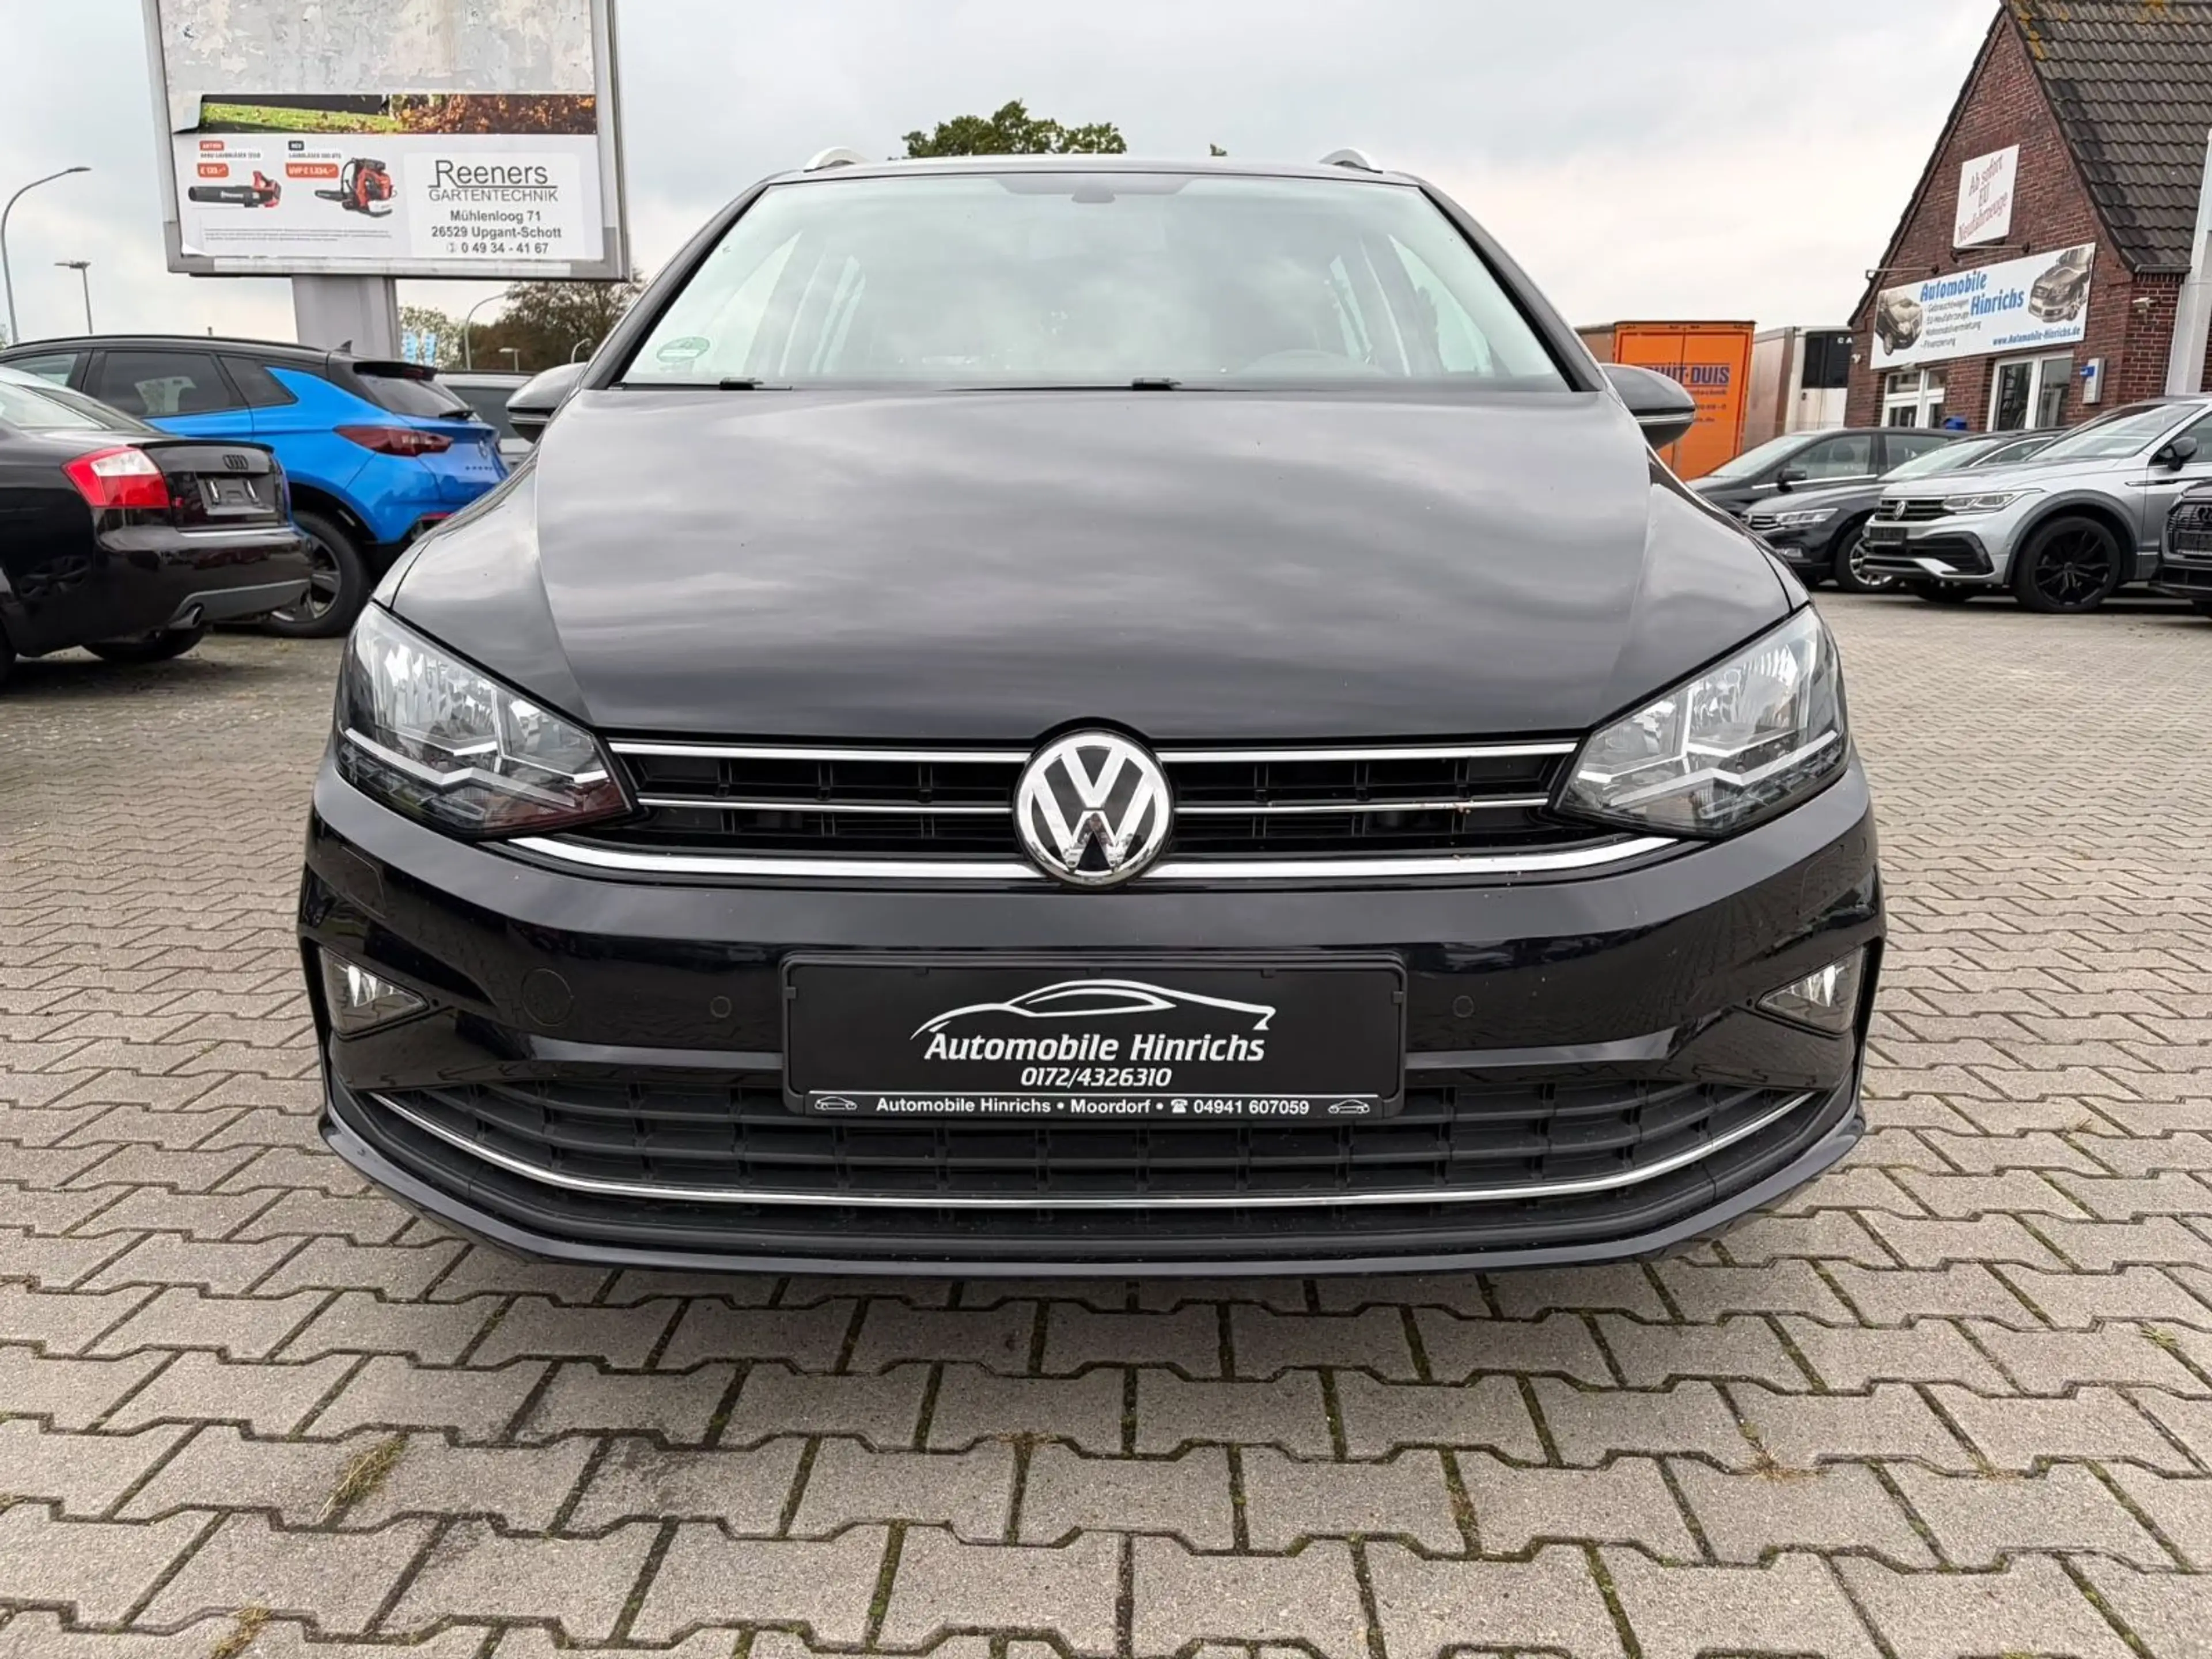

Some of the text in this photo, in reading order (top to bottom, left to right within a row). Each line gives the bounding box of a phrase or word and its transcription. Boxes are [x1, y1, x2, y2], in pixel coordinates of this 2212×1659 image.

[435, 160, 548, 188] Reeners
[428, 189, 559, 202] GARTENTECHNIK
[450, 210, 541, 224] Mühlenloog 71
[431, 226, 562, 240] 26529 Upgant-Schott
[472, 242, 487, 253] 49
[491, 242, 505, 253] 34
[516, 242, 530, 253] 41
[534, 242, 548, 253] 67
[1920, 270, 1987, 302] Automobile
[1970, 289, 2025, 316] Hinrichs
[923, 1033, 1265, 1061] Automobile Hinrichs
[1020, 1067, 1173, 1089] 0172/4326310
[876, 1097, 1310, 1115] Automobile Hinrichs Moordorf 04941 607059
